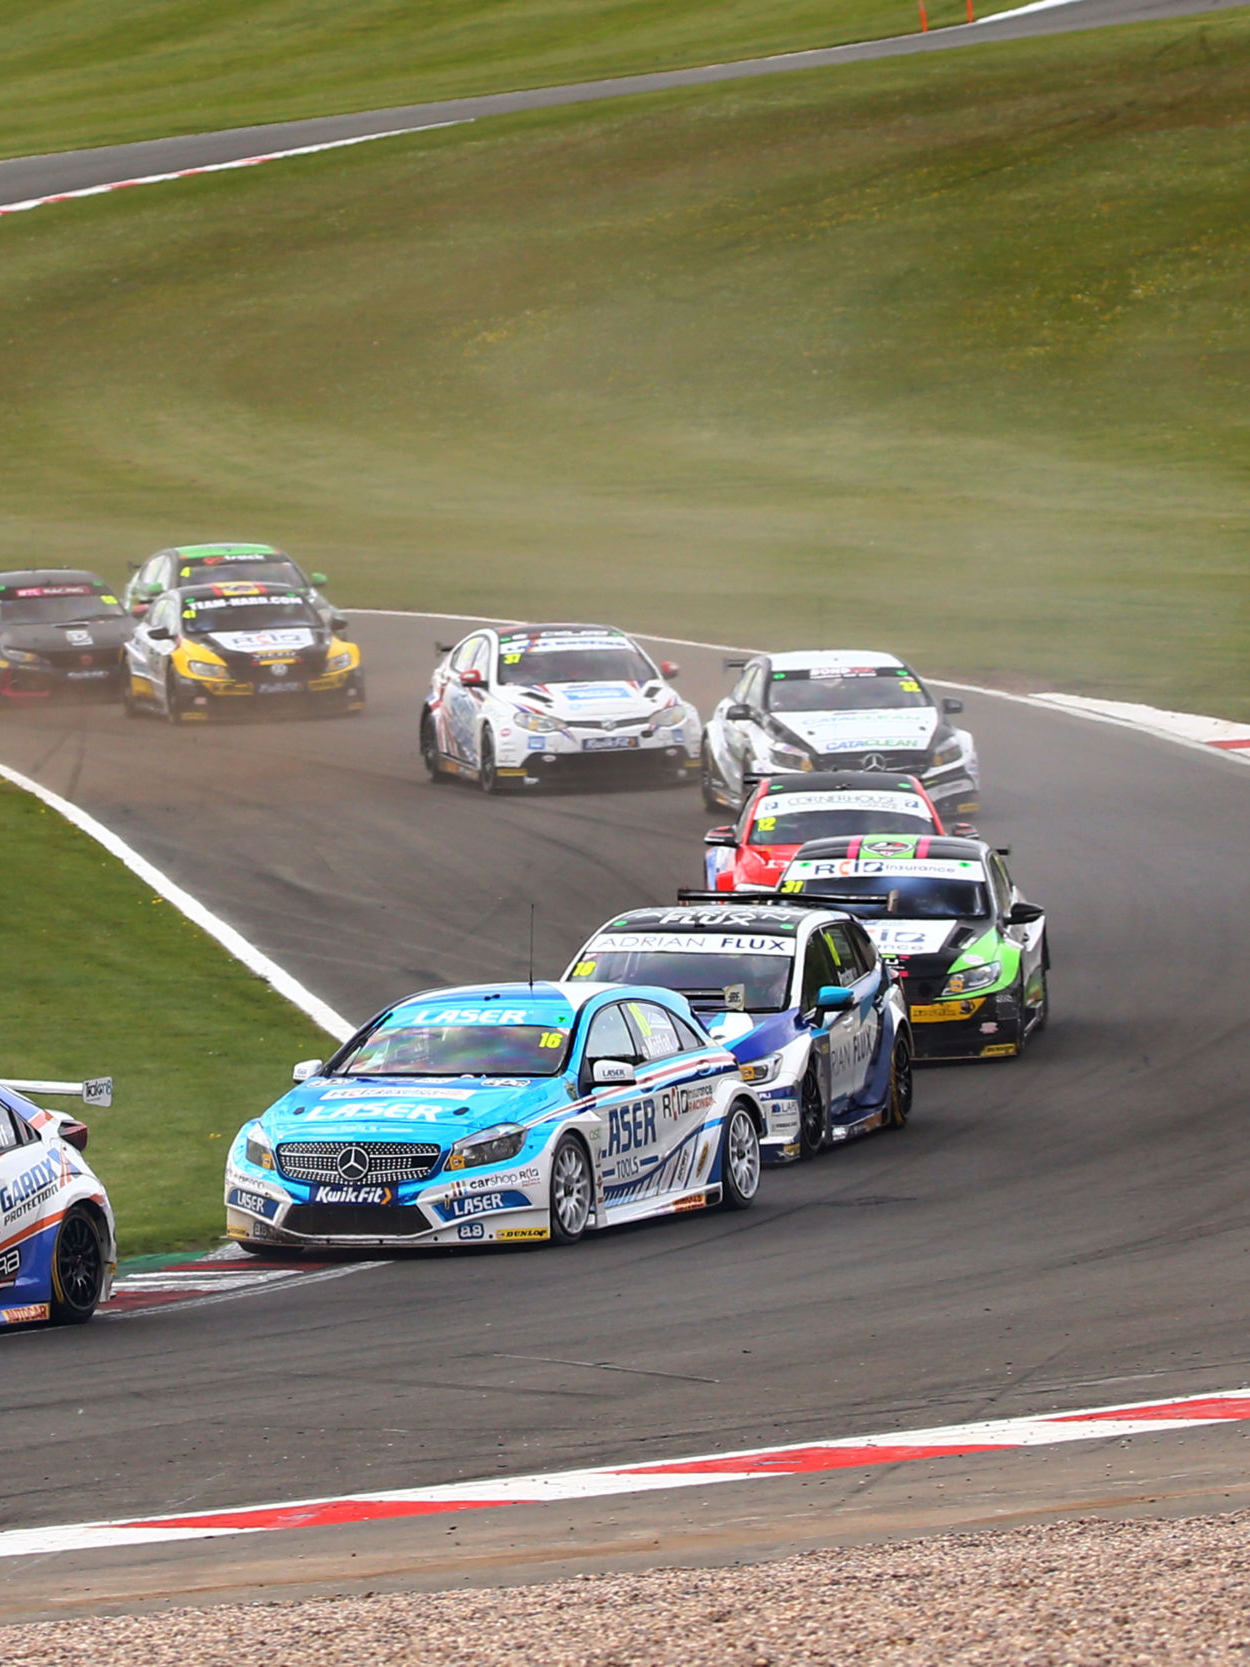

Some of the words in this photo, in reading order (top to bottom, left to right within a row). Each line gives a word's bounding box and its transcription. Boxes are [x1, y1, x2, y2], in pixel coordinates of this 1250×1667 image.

[180, 567, 191, 577] 4
[503, 653, 521, 665] 37
[826, 739, 918, 751] CATACLEAN
[781, 880, 804, 893] 31
[600, 936, 706, 948] ADRIAN
[720, 937, 786, 951] FLUX
[572, 961, 597, 977] 18
[412, 1009, 527, 1025] LASER
[538, 1031, 563, 1049] 16
[602, 1069, 625, 1077] LASER
[305, 1103, 443, 1122] LASER
[617, 1156, 639, 1180] TOOLS
[470, 1172, 518, 1190] carshop
[4, 1183, 59, 1226] PROTECTION
[453, 1193, 504, 1217] LASER
[505, 1229, 547, 1238] DUNLOP
[5, 1304, 48, 1322] AUTOCAR
